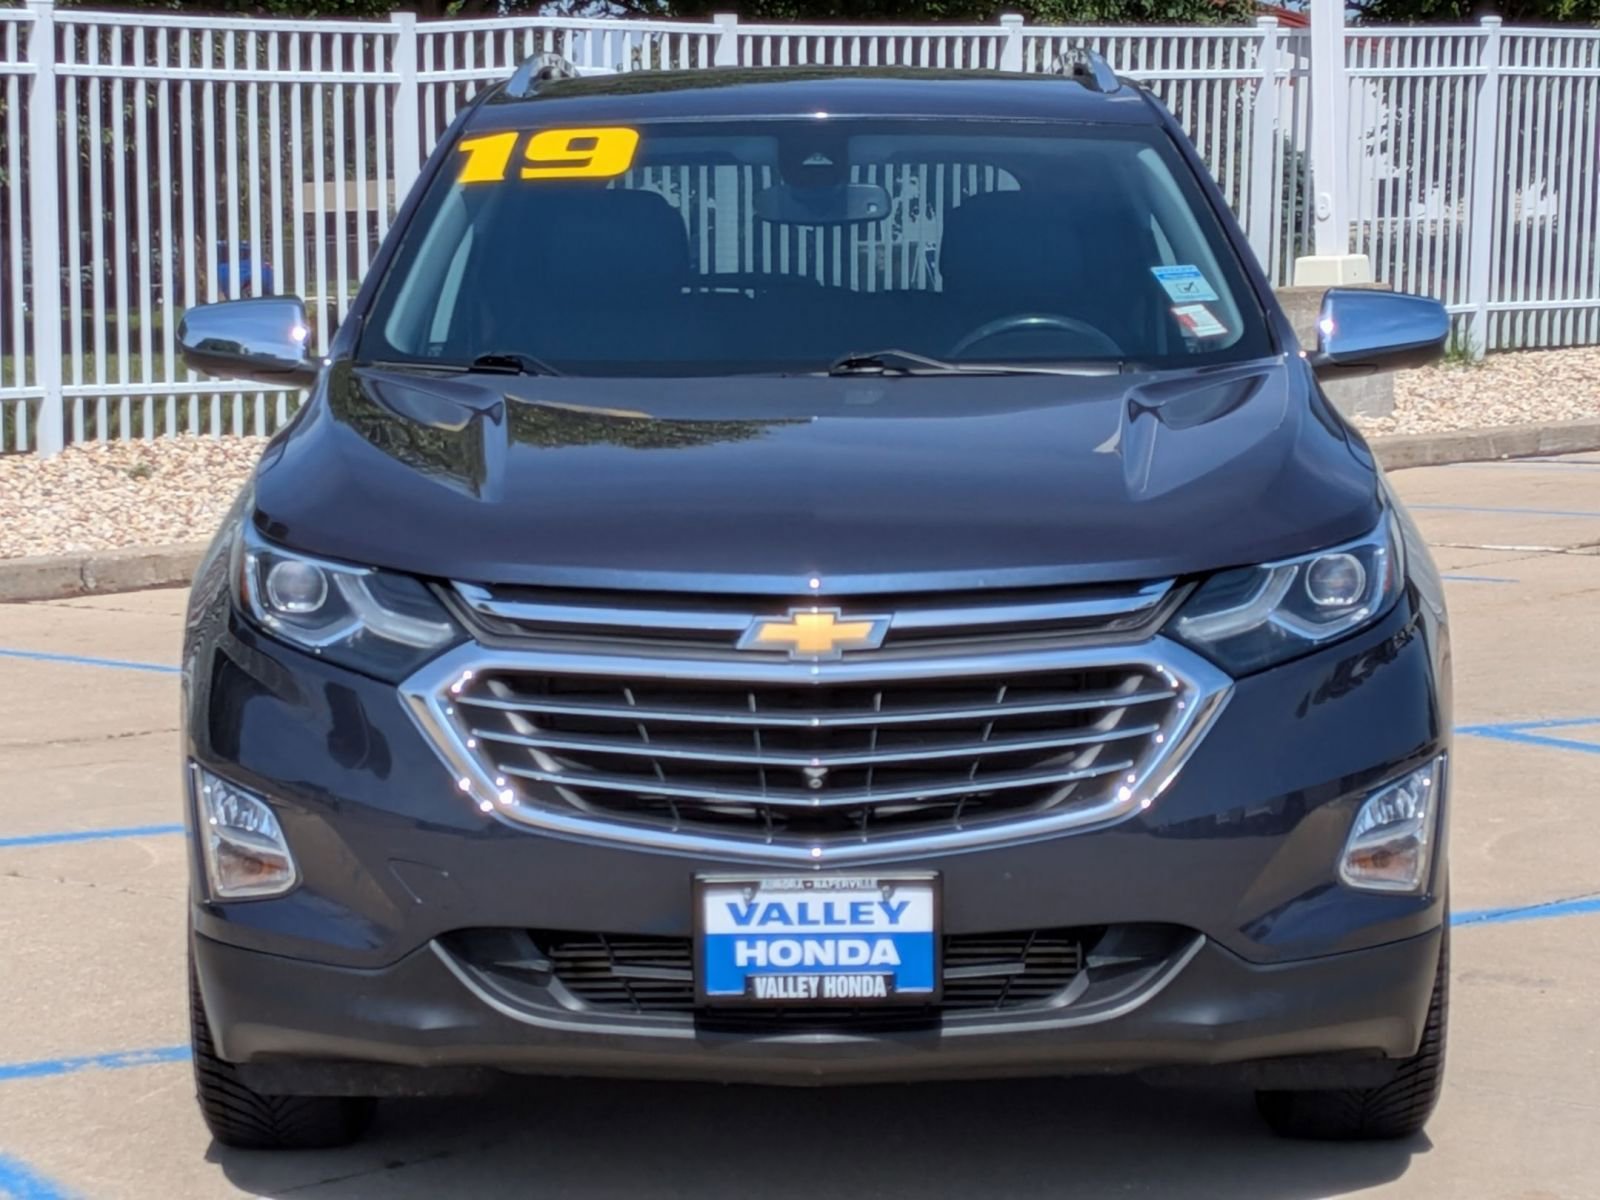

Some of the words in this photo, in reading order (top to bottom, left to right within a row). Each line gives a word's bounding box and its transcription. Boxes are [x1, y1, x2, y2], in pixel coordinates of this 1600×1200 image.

[458, 127, 640, 184] 19
[726, 901, 911, 926] VALLEY
[735, 939, 901, 967] HONDA
[755, 976, 819, 999] VALLEY
[823, 975, 887, 998] HONDA
